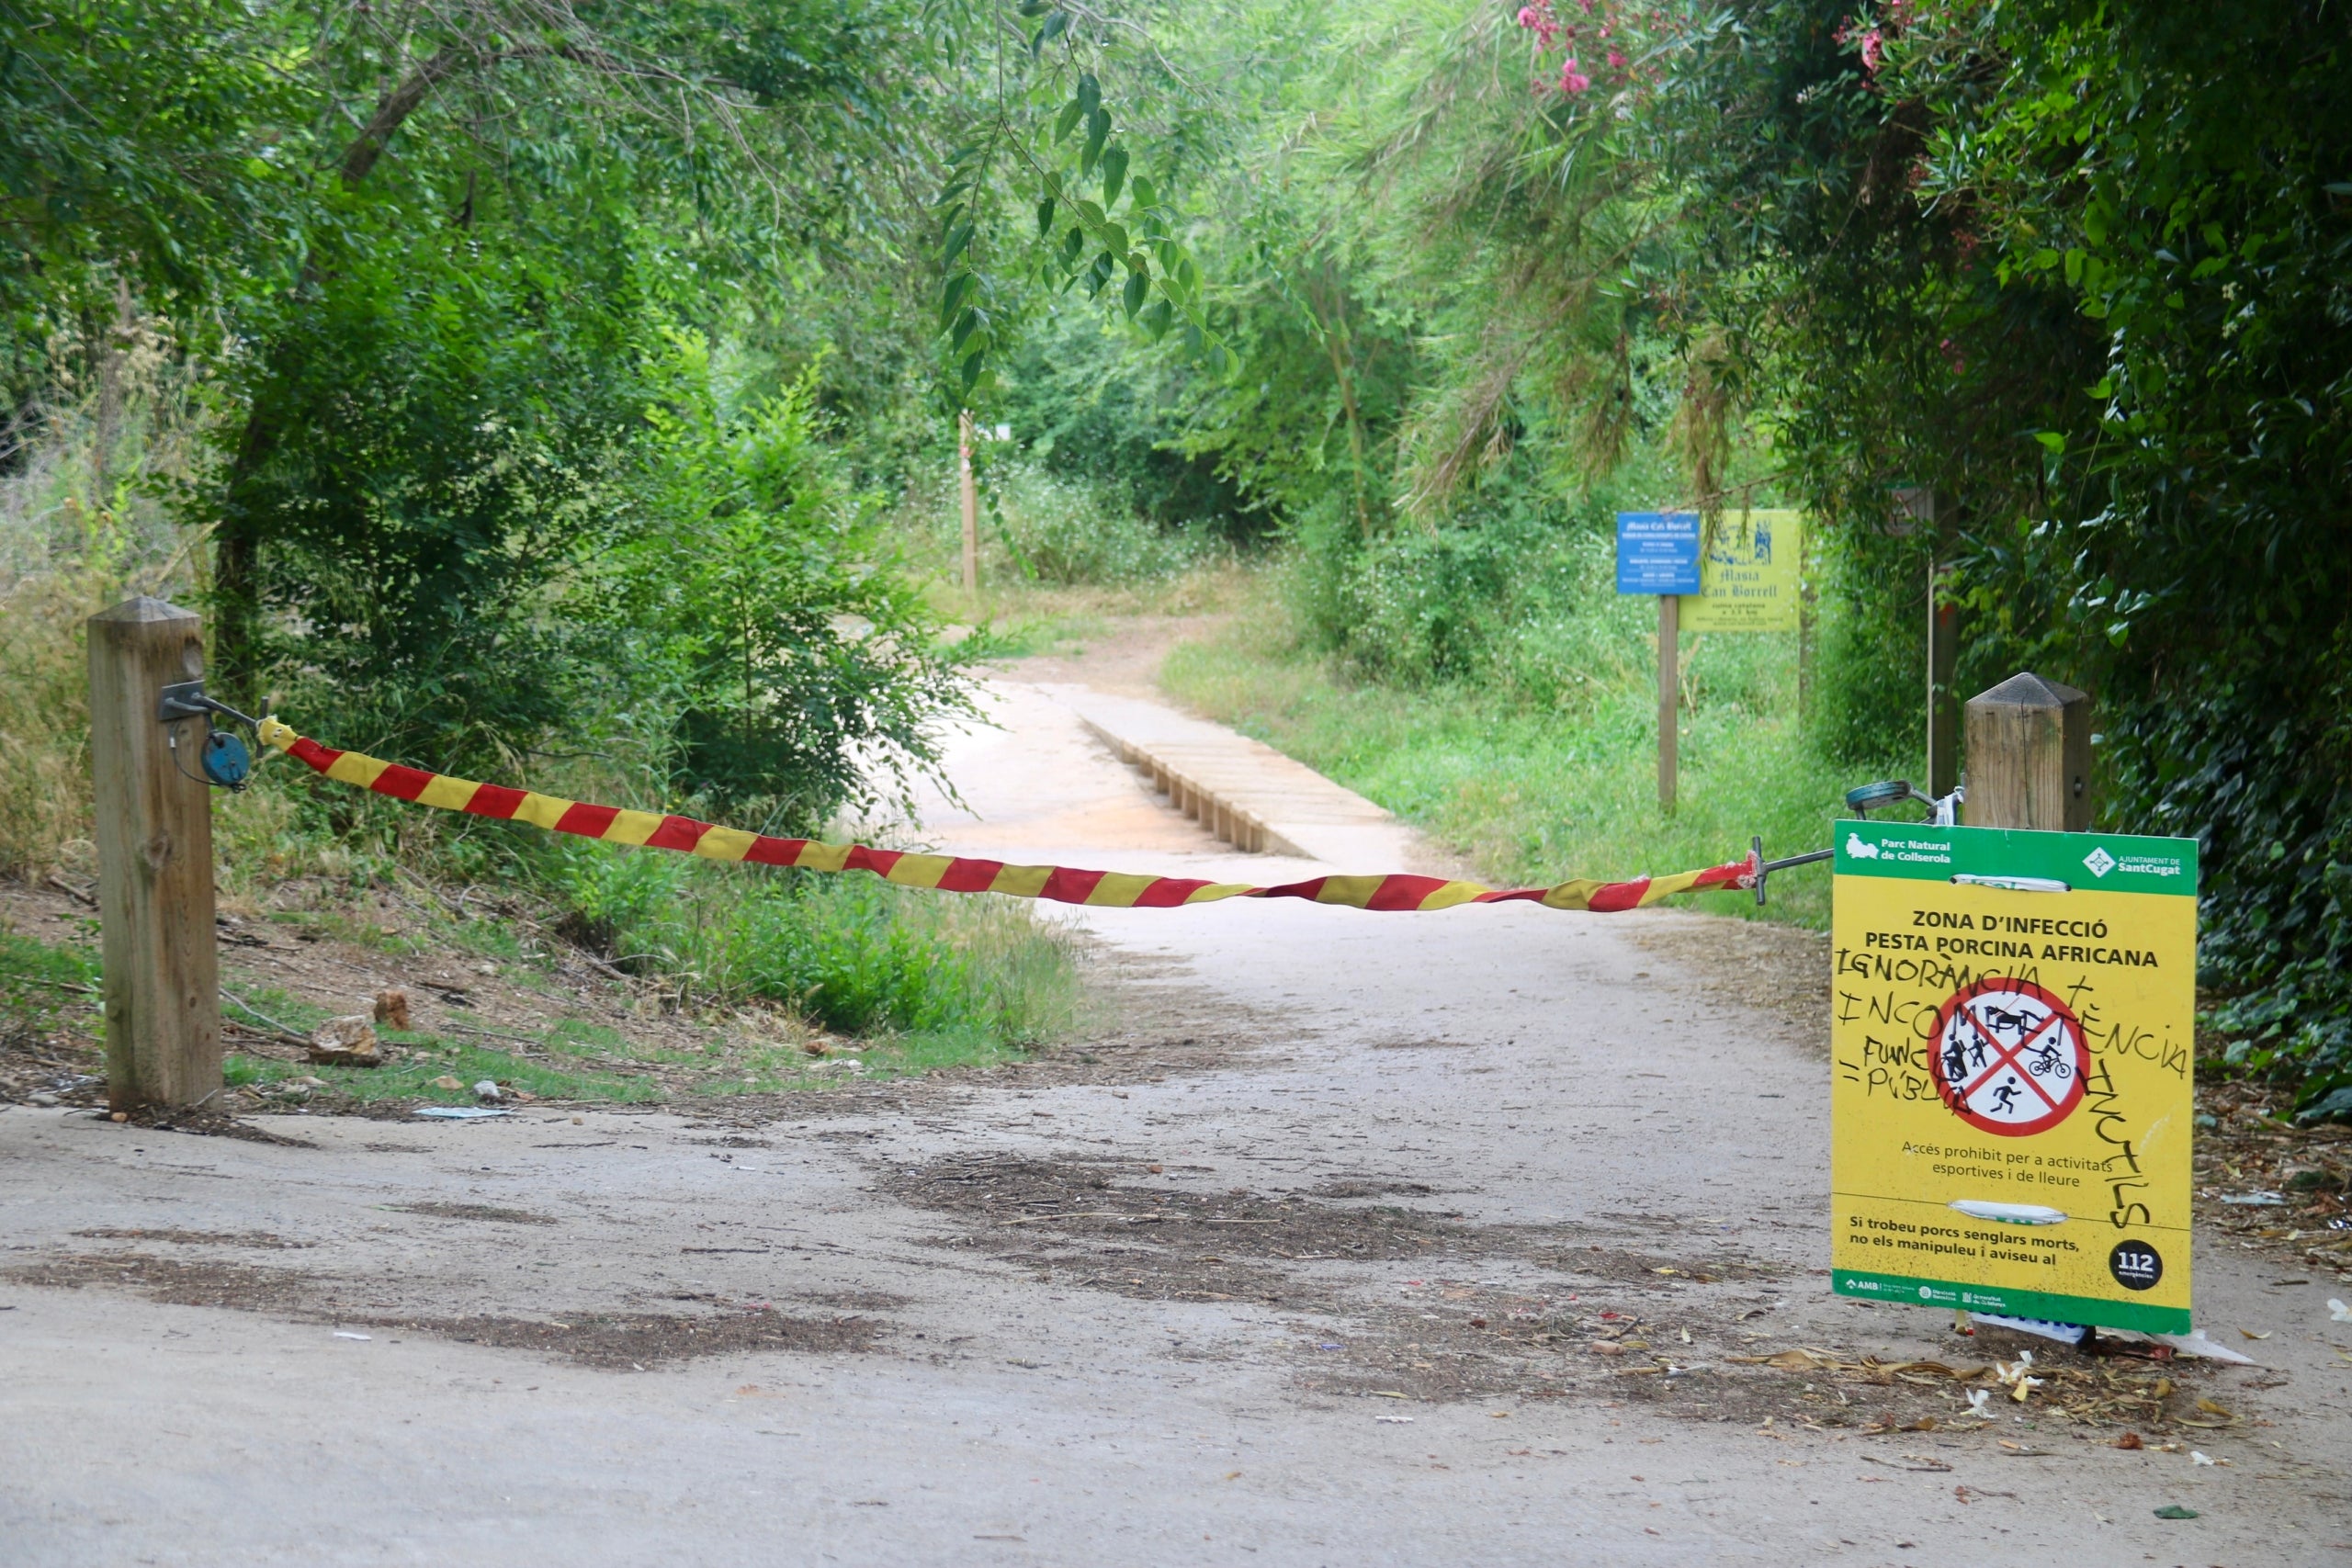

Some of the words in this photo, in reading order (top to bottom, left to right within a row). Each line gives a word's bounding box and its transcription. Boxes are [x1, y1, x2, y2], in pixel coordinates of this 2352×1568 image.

[1720, 570, 1759, 582] Masia
[1701, 585, 1726, 598] Can
[1732, 585, 1777, 598] Borrell
[1881, 838, 1905, 851] Parc
[1907, 840, 1951, 852] Natural
[1881, 850, 1894, 860] de
[1895, 851, 1951, 863] Collserola
[2119, 856, 2168, 864] AJUNTAMENT
[2119, 863, 2180, 876] SantCugat
[1912, 910, 1974, 930] ZONA
[1982, 915, 2108, 939] D'INFECCIÓ
[1865, 931, 1929, 952] PESTA
[1936, 937, 2034, 959] PORCINA
[2041, 944, 2158, 967] AFRICANA
[1902, 1140, 1940, 1156] Accés
[1944, 1145, 2003, 1163] prohibit
[2006, 1152, 2030, 1167] per
[2034, 1156, 2042, 1165] a
[2047, 1156, 2113, 1173] activitats
[1932, 1162, 2004, 1180] esportives
[2007, 1167, 2011, 1179] i
[2017, 1168, 2034, 1182] de
[2039, 1171, 2081, 1188] lleure
[1849, 1215, 1863, 1228] Si
[1867, 1218, 1917, 1233] trobeu
[1920, 1224, 1961, 1240] porcs
[1964, 1227, 2027, 1246] senglars
[2030, 1235, 2080, 1252] morts,
[1849, 1235, 1869, 1245] no
[1872, 1234, 1894, 1247] els
[1896, 1239, 1976, 1258] manipuleu
[1981, 1245, 1985, 1257] i
[1989, 1247, 2038, 1264] aviseu
[2042, 1253, 2056, 1266] al
[2119, 1252, 2154, 1271] 112
[1858, 1280, 1878, 1291] AMB
